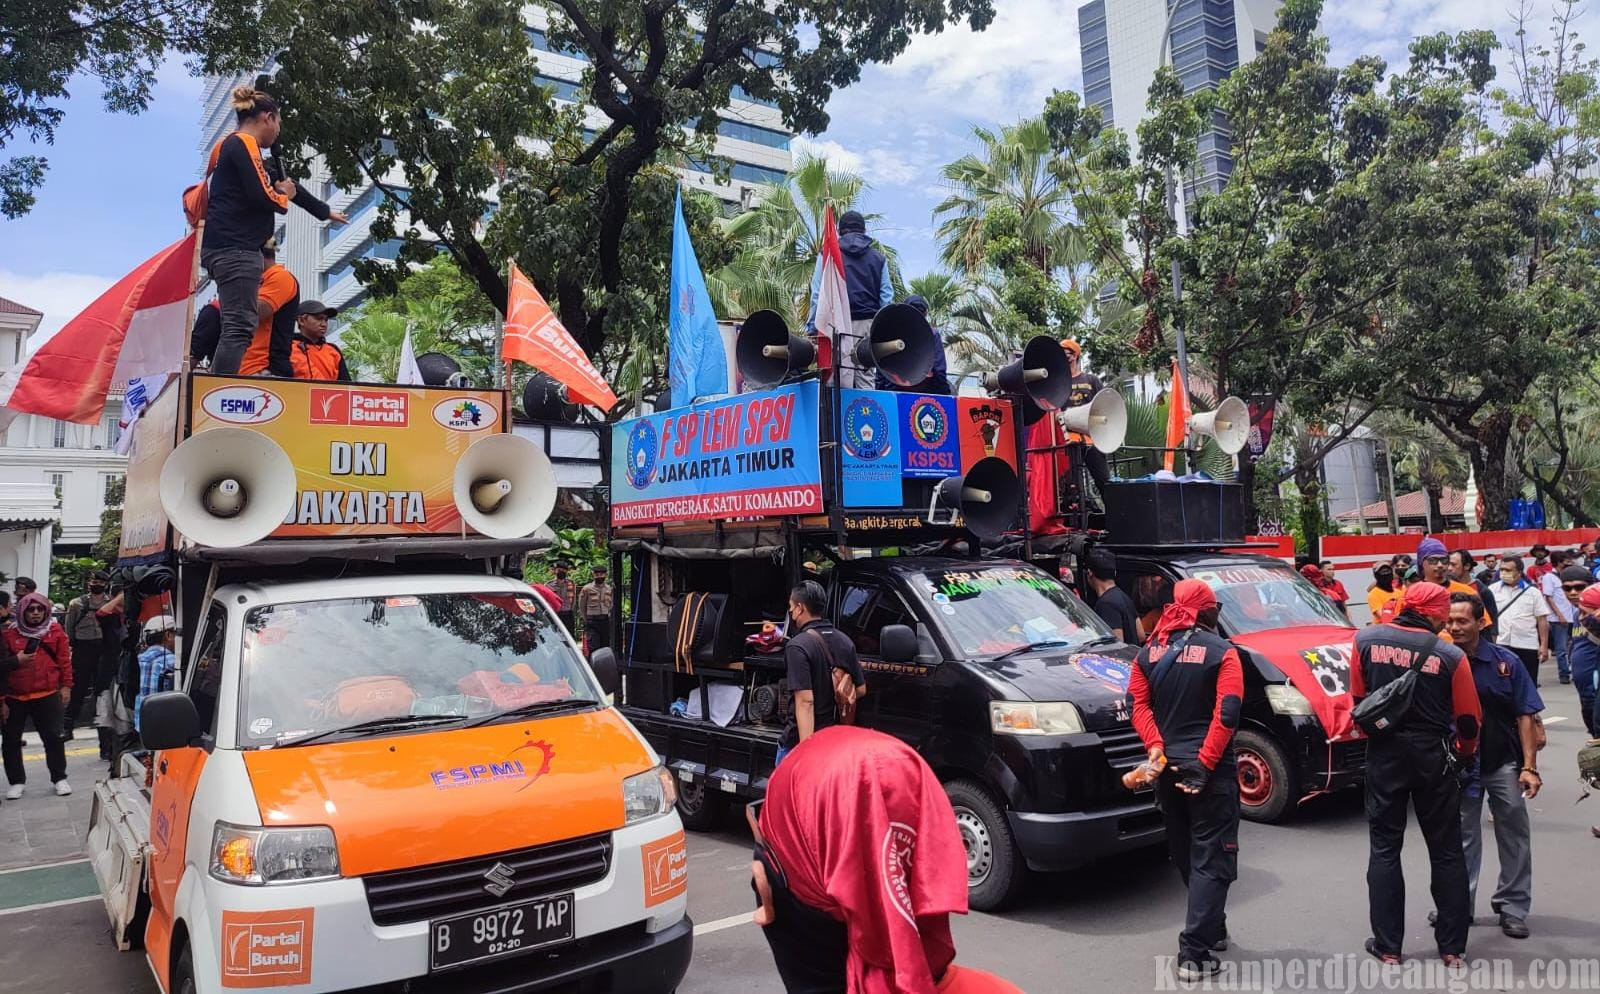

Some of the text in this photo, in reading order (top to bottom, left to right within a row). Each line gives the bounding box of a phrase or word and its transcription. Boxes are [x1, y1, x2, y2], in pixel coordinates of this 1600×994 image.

[221, 398, 255, 413] FSPMI
[352, 394, 404, 410] Partai
[352, 408, 404, 423] Buruh
[659, 392, 795, 459] F SP LEM SPSI
[330, 441, 387, 476] DKI
[658, 447, 795, 484] JAKARTA TIMUR
[907, 451, 954, 468] KSPSI
[745, 489, 815, 511] KOMANDO
[1371, 644, 1411, 669] BAPOR
[430, 759, 525, 786] FSPMI
[437, 899, 569, 953] B 9972 TAP
[252, 931, 300, 948] Partai
[251, 950, 299, 967] Buruh
